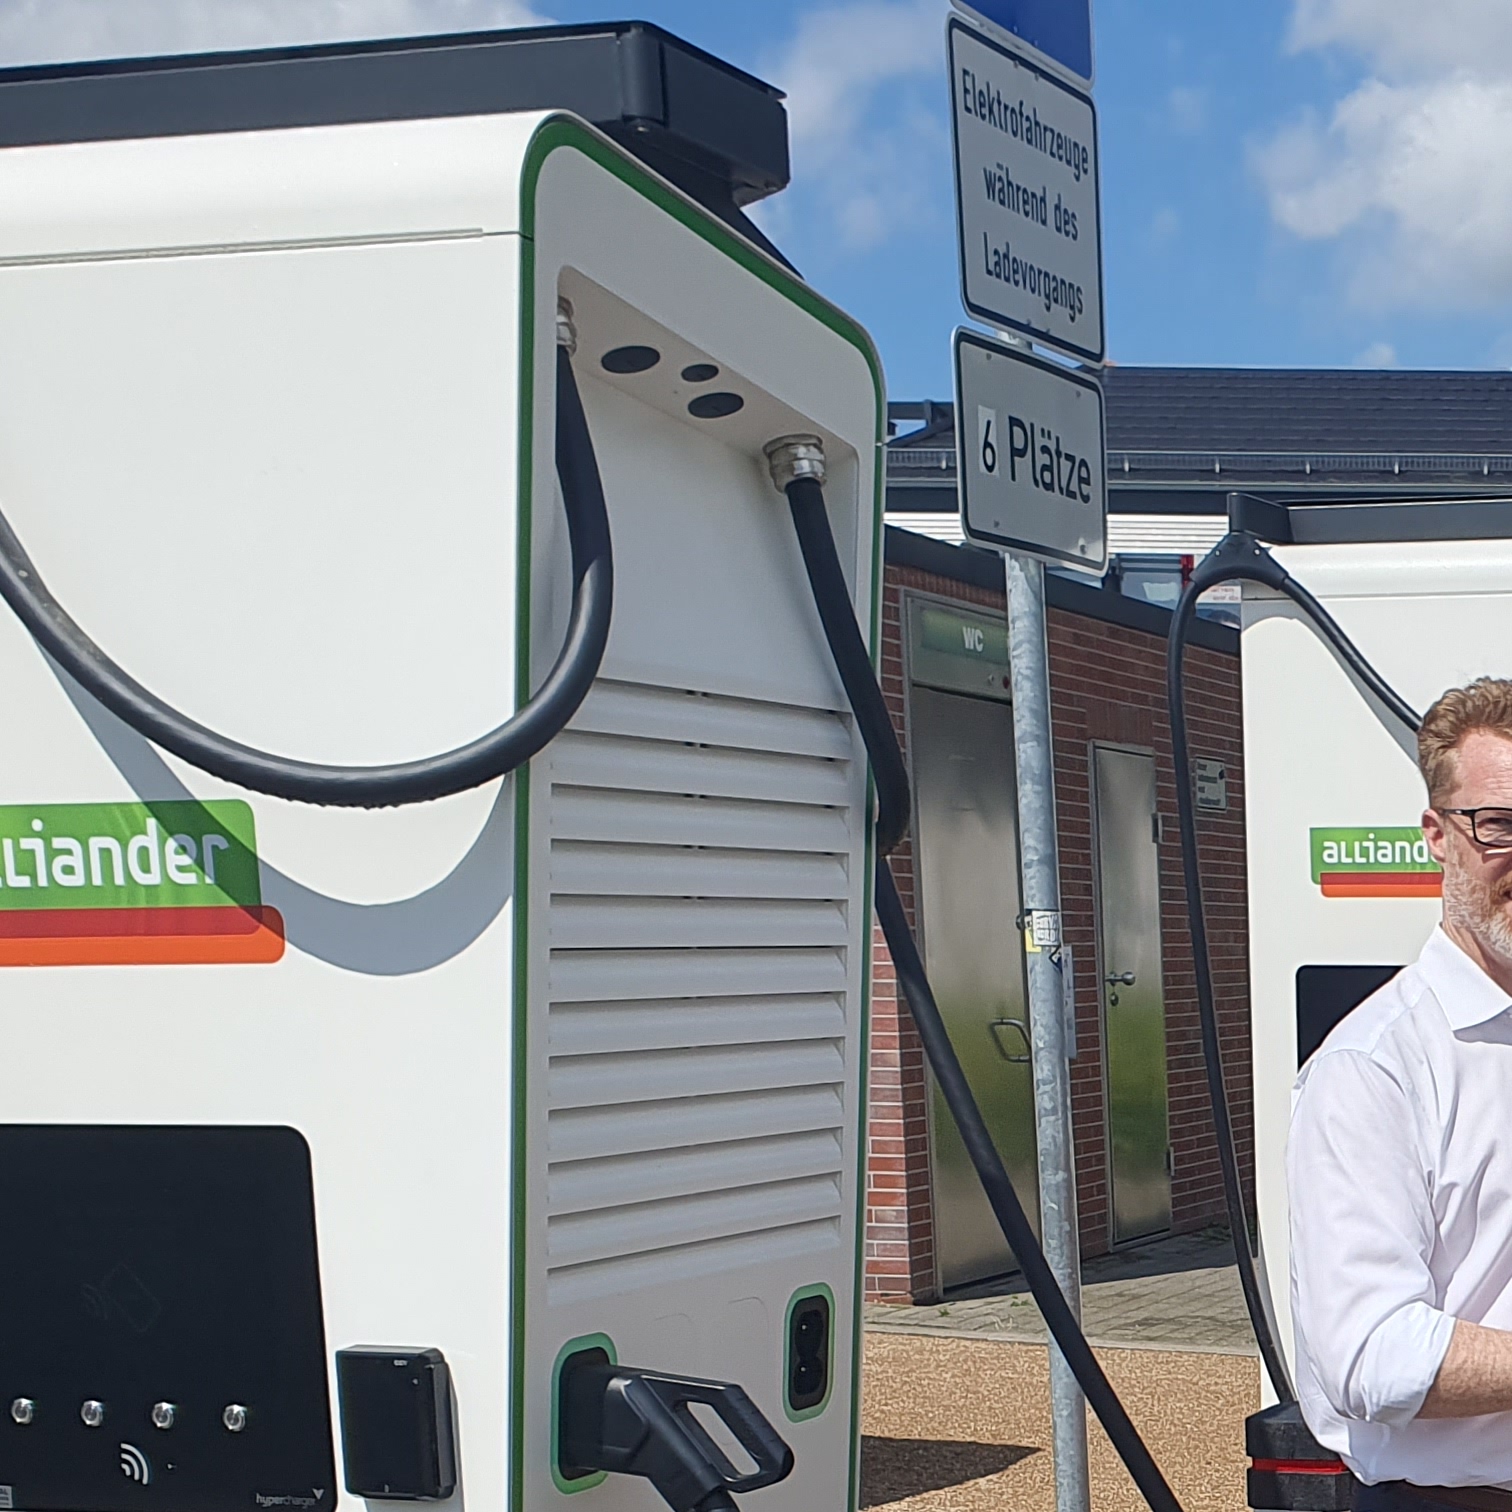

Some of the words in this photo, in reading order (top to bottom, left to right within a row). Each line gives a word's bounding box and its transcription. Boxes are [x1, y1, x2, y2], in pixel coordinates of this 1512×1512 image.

[961, 67, 1089, 183] Elektrofahrzeuge
[982, 162, 1048, 229] während
[1053, 205, 1080, 243] des
[983, 231, 1083, 324] Ladevorgangs
[981, 418, 997, 474] 6
[1007, 414, 1092, 505] Plätze
[962, 625, 984, 653] WC
[1322, 832, 1439, 864] alliand
